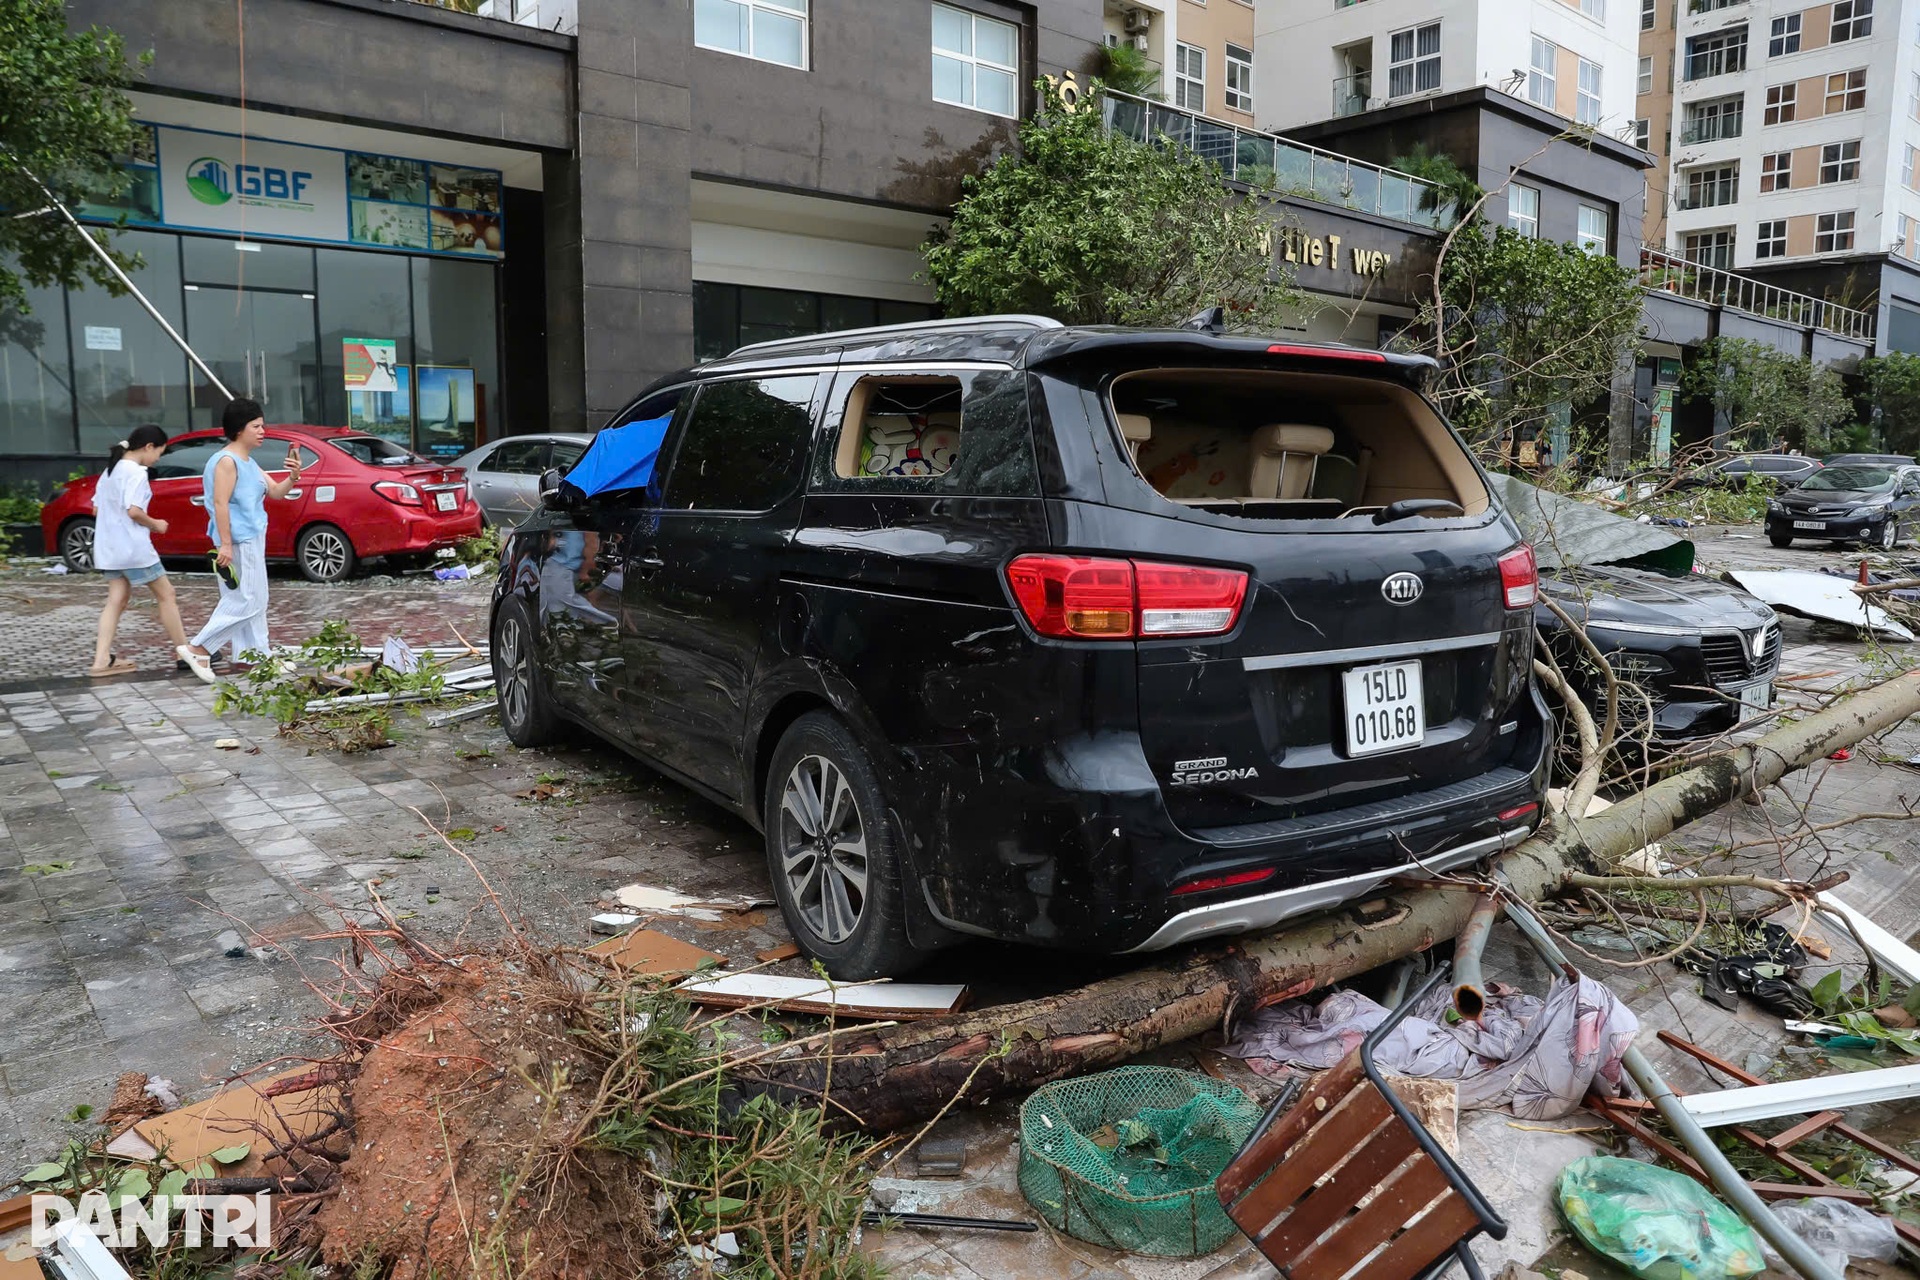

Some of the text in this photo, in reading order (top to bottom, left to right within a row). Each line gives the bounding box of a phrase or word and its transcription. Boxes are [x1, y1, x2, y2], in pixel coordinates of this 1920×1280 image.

[235, 164, 313, 201] GBF
[1389, 579, 1419, 599] KIA
[1362, 668, 1407, 705] 15LD
[1355, 705, 1416, 745] 010.68
[1169, 766, 1260, 786] SEDONA
[1178, 759, 1225, 770] GRAND
